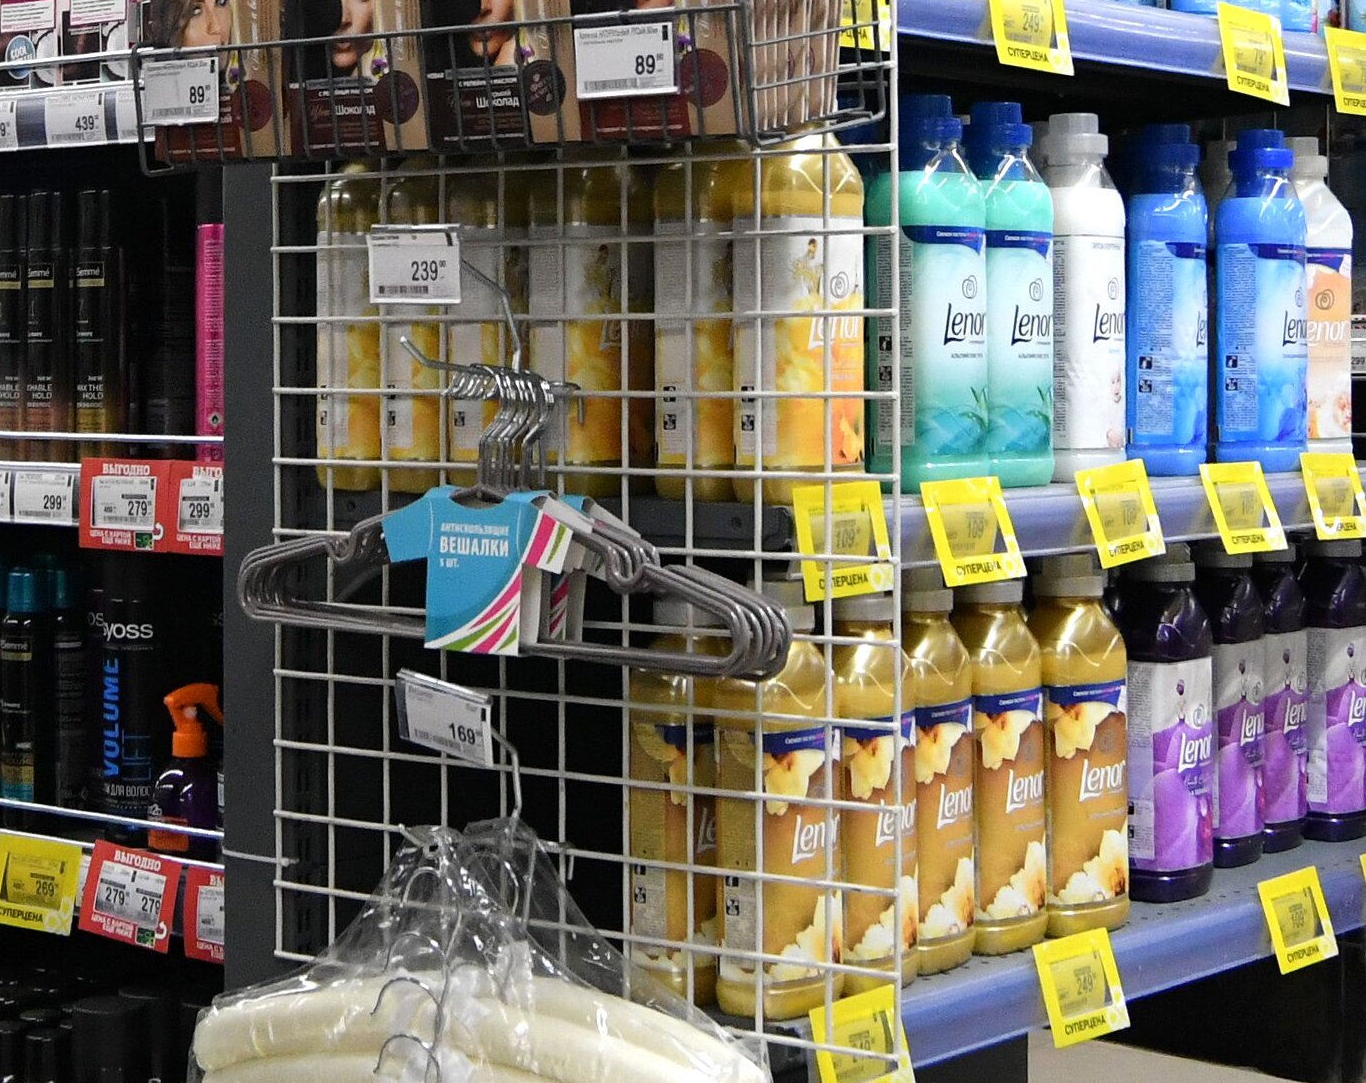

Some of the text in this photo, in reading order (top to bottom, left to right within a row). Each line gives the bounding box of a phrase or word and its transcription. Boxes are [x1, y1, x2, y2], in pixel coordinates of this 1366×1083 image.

[1023, 12, 1041, 33] 249
[11, 47, 27, 58] COOL
[1008, 45, 1049, 64] СУПЕРЦЕНА
[635, 54, 656, 75] 89
[1236, 75, 1270, 93] СУПЕРЦЕНА
[189, 85, 205, 104] 89
[75, 115, 95, 131] 439
[411, 260, 438, 282] 239
[0, 392, 20, 400] HOLD
[32, 392, 52, 400] HOLD
[83, 392, 104, 400] HOLD
[102, 463, 151, 476] ВЫГОДНО
[43, 494, 61, 510] 299
[128, 500, 148, 516] 279
[189, 503, 210, 518] 299
[440, 536, 509, 557] ВЕШАЛКИ
[1231, 533, 1265, 546] СУПЕРЦЕНА
[103, 657, 120, 778] VOLUME
[449, 722, 476, 745] 169
[1079, 758, 1126, 802] Lenor
[114, 849, 161, 872] ВЫГОДНО
[36, 880, 54, 897] 269
[105, 886, 125, 906] 279
[141, 895, 160, 915] 279
[1287, 945, 1320, 964] СУПЕРЦЕНА
[1076, 975, 1094, 997] 249
[1064, 1014, 1107, 1037] СУПЕРЦЕНА
